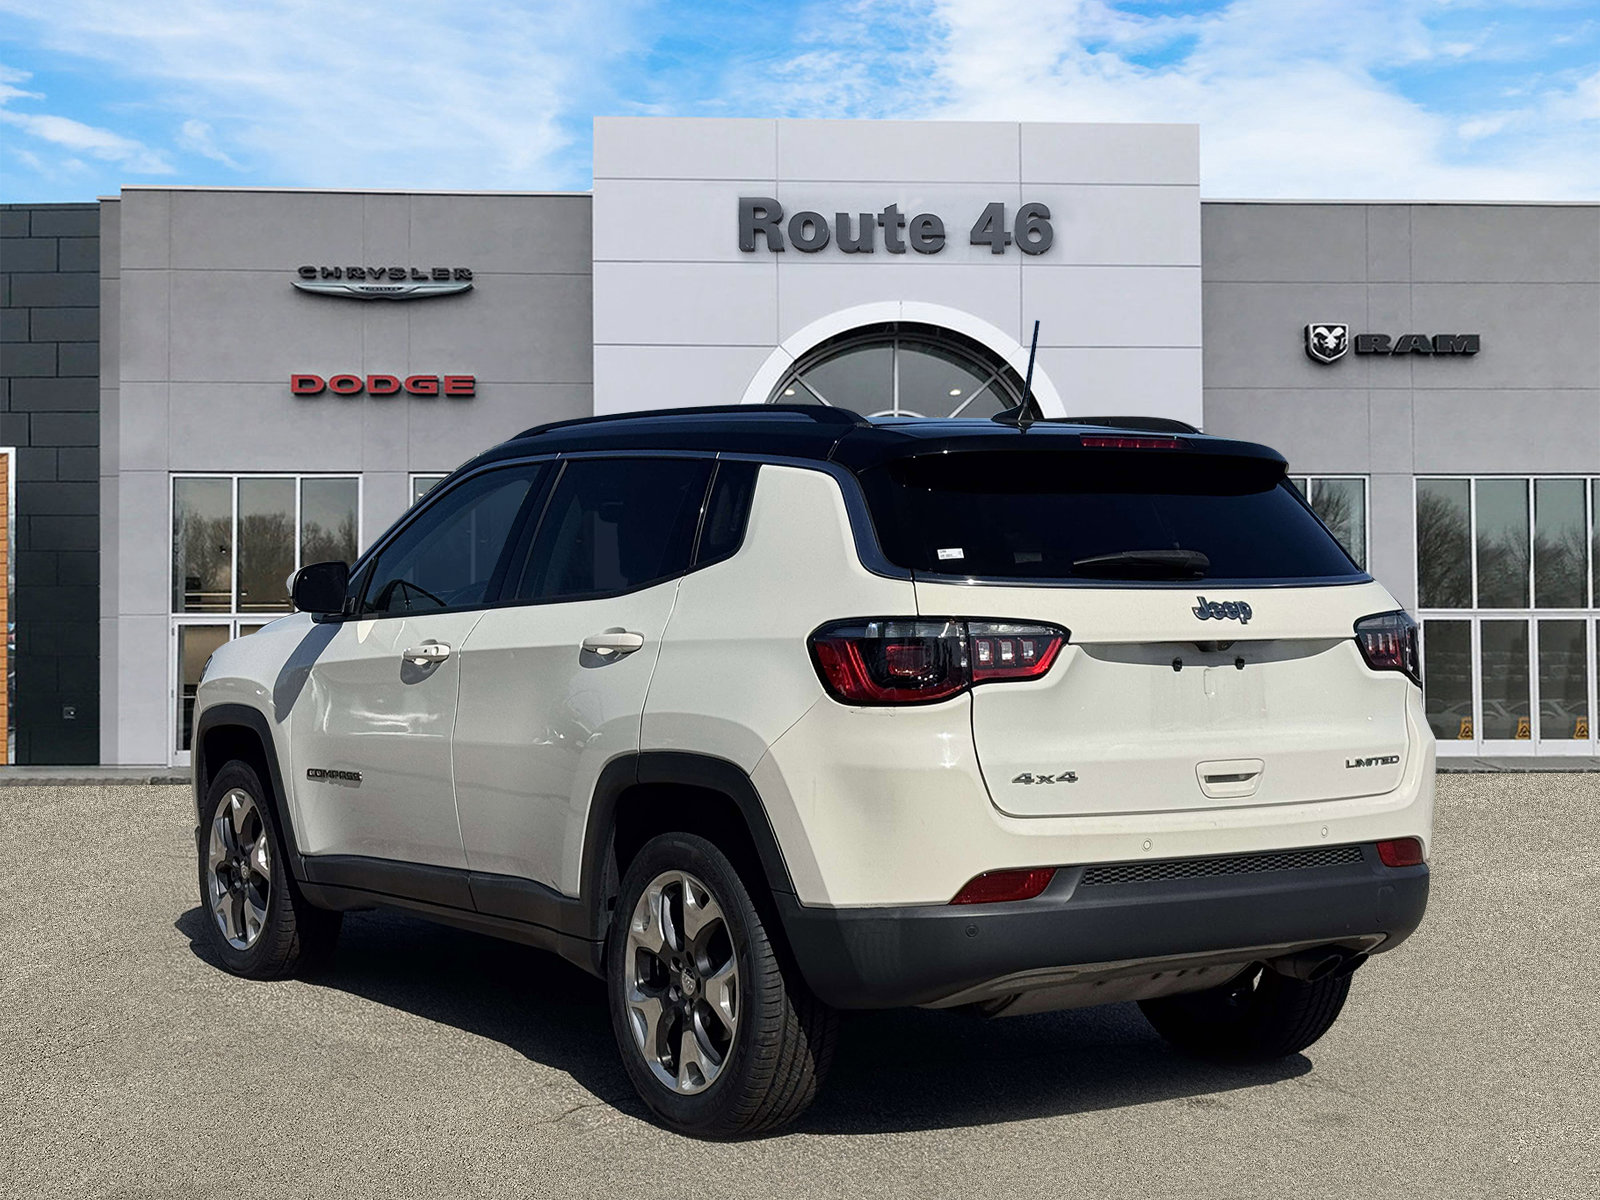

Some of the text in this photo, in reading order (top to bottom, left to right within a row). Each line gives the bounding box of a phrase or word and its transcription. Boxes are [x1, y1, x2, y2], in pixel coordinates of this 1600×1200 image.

[738, 196, 1054, 256] Route 46
[298, 265, 473, 281] CHRYSLER
[1354, 333, 1480, 356] RAM
[290, 373, 476, 397] DODGE
[1191, 595, 1253, 625] Jeep
[1345, 754, 1400, 769] LIMITED
[306, 768, 363, 782] COMPASS
[1011, 770, 1079, 785] 4x4
